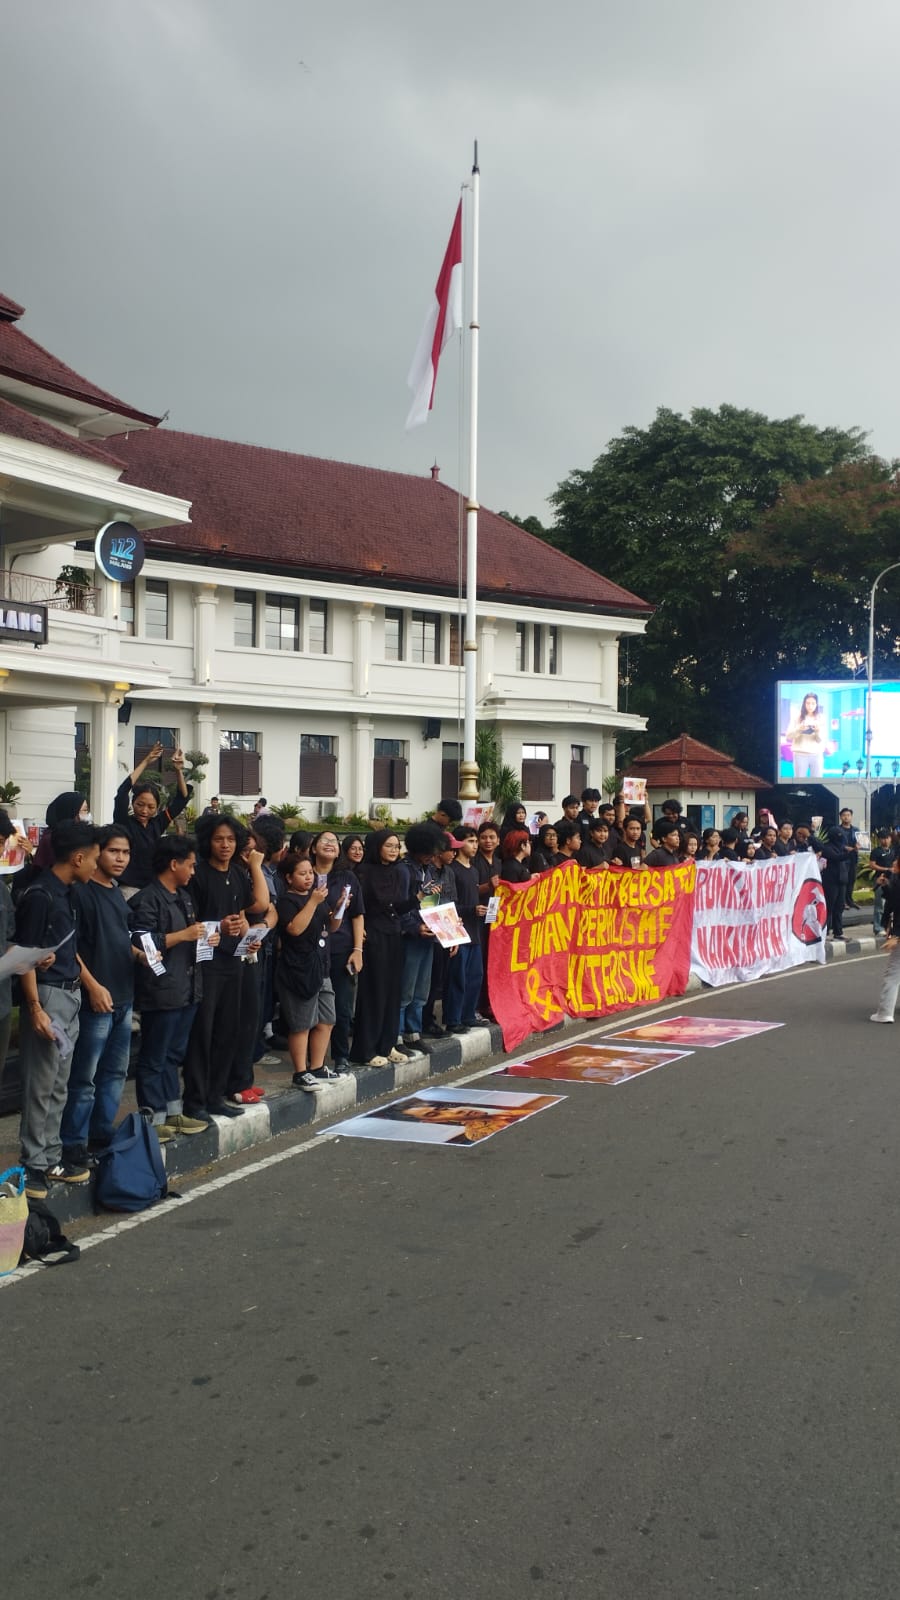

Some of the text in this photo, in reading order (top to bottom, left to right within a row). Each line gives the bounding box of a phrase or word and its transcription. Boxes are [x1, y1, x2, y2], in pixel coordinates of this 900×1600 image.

[110, 538, 136, 560] 112
[619, 864, 696, 907] BERSATU
[510, 906, 577, 972] LAWAN
